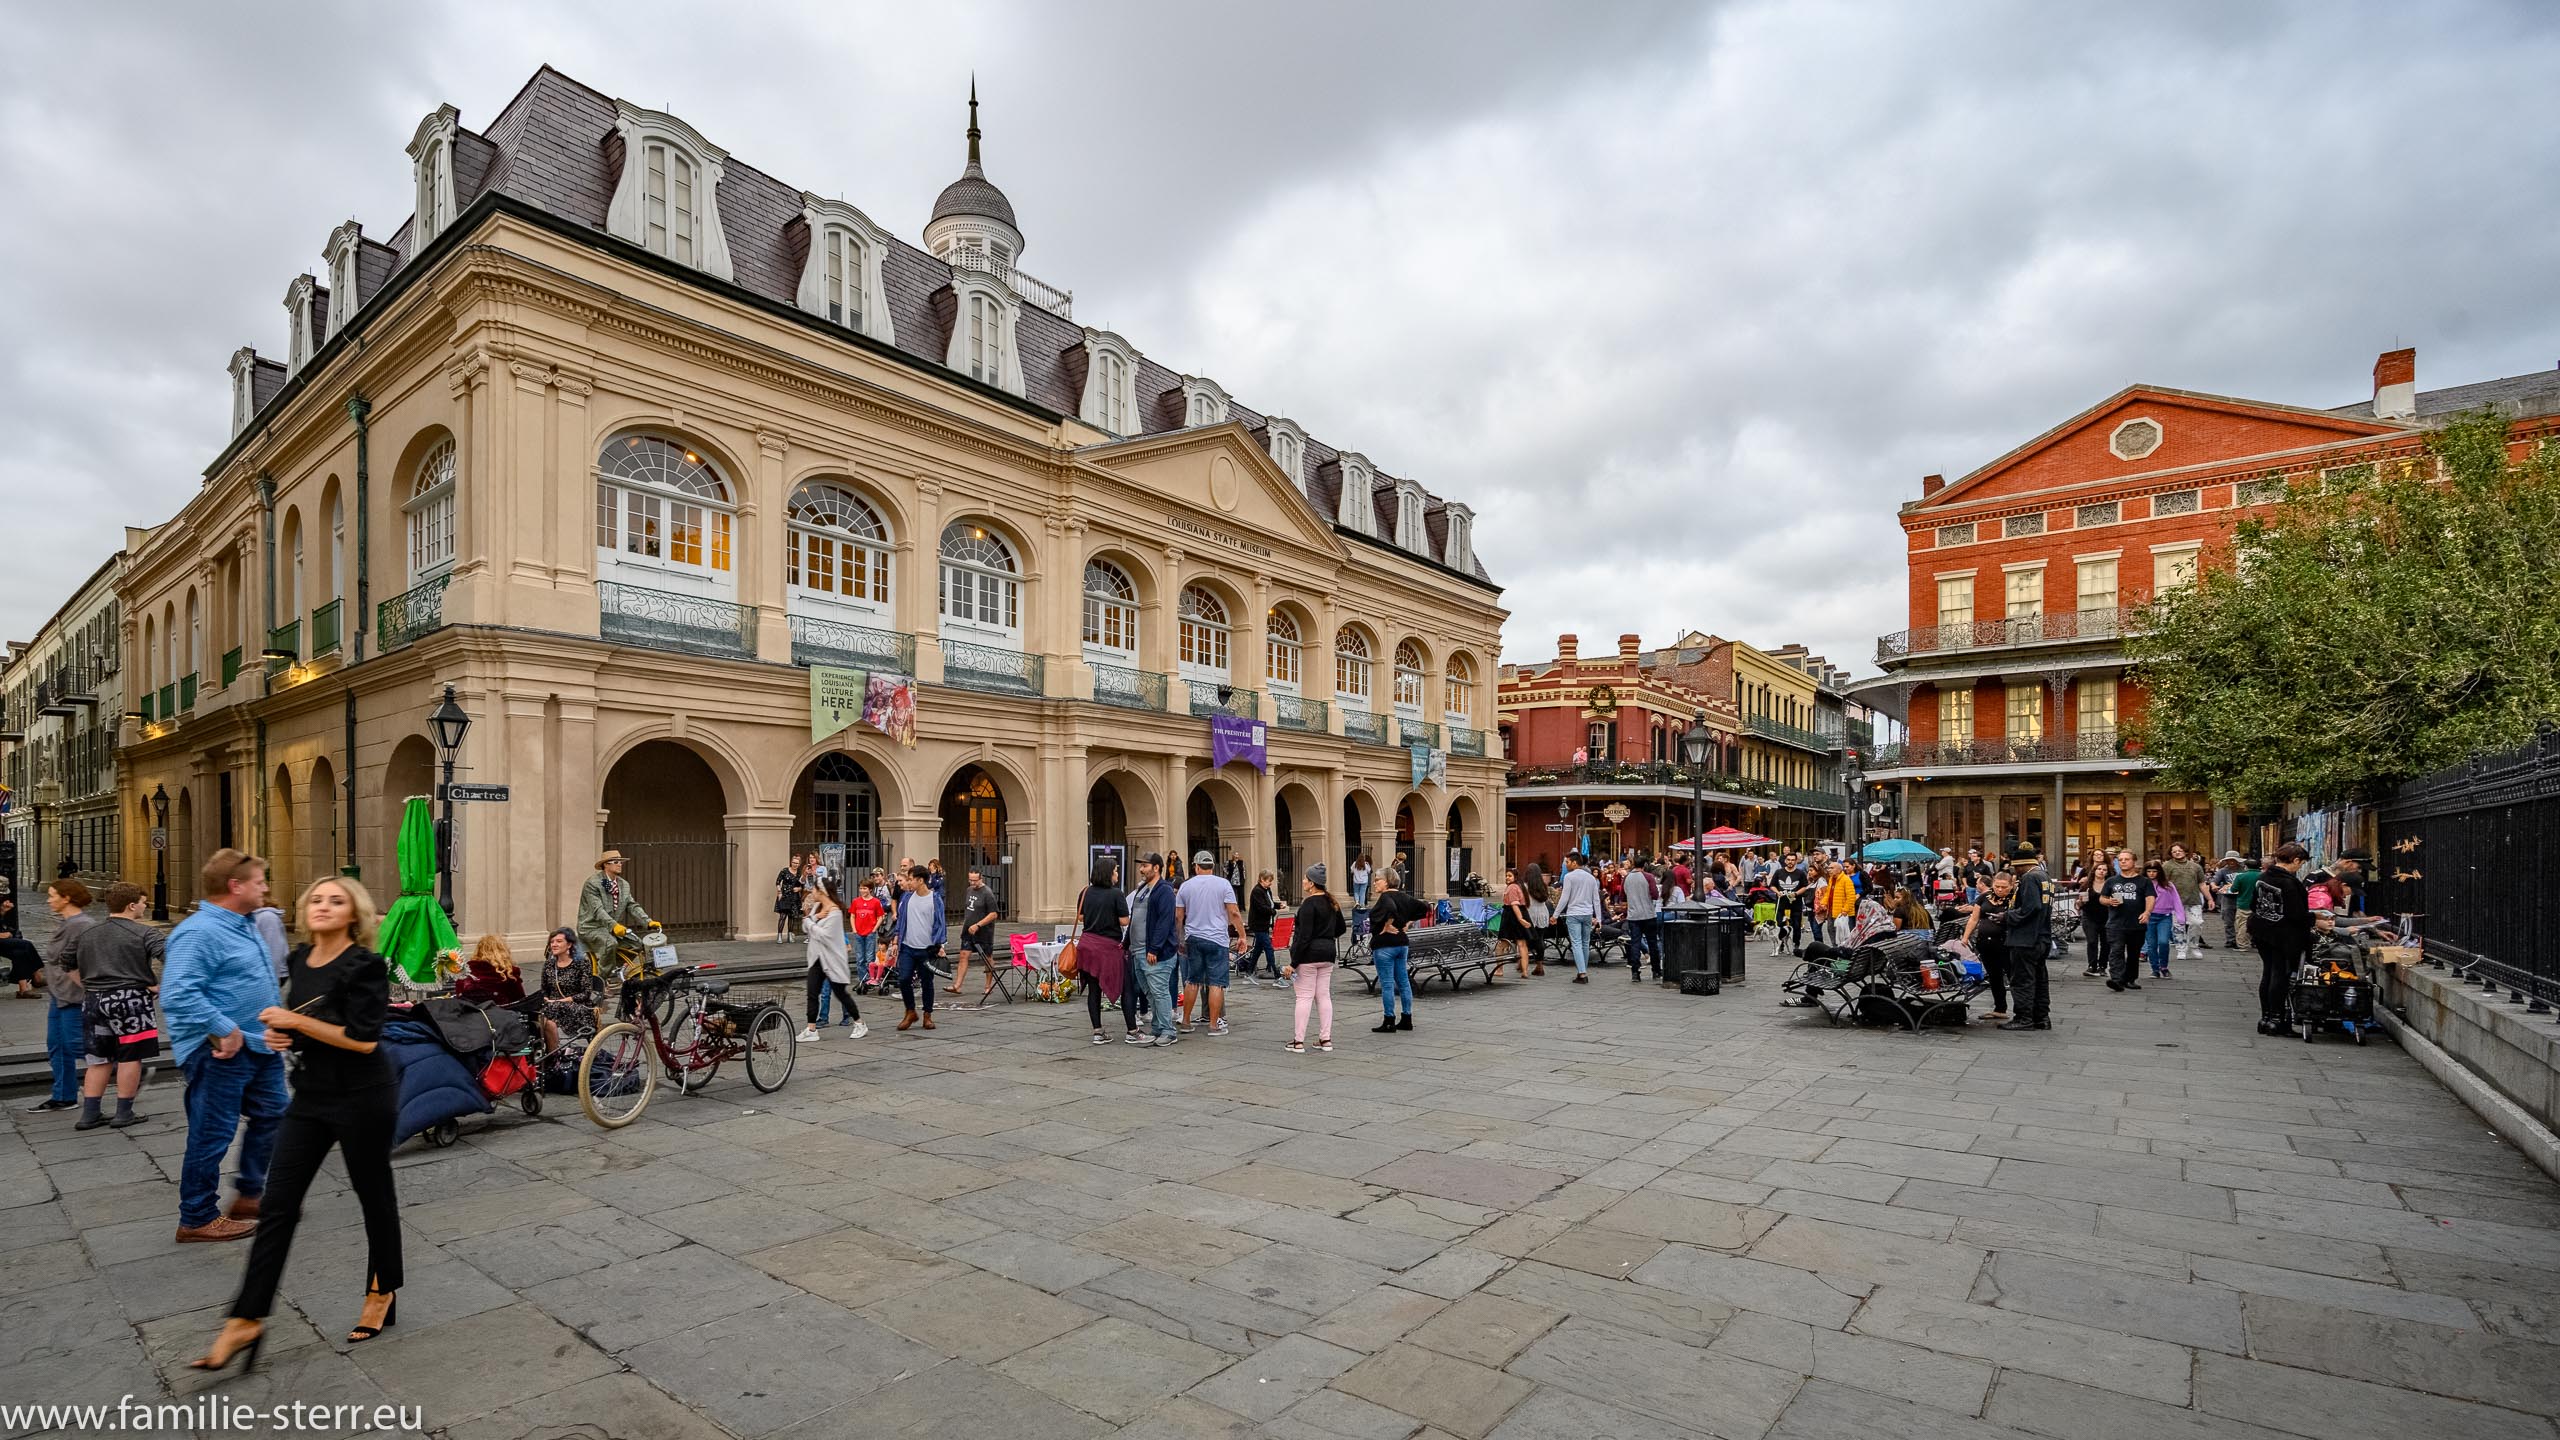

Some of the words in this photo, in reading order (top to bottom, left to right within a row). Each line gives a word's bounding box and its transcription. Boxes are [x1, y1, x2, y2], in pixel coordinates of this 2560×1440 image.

[1167, 516, 1211, 539] LOUISIANA
[1213, 532, 1238, 548] STATE
[1240, 541, 1271, 559] MUSEUM
[821, 672, 855, 682] EXPERIENCE
[821, 680, 854, 689] LOUISIANA
[821, 687, 854, 697] CULTURE
[821, 696, 854, 710] HERE
[451, 788, 507, 800] Chartres
